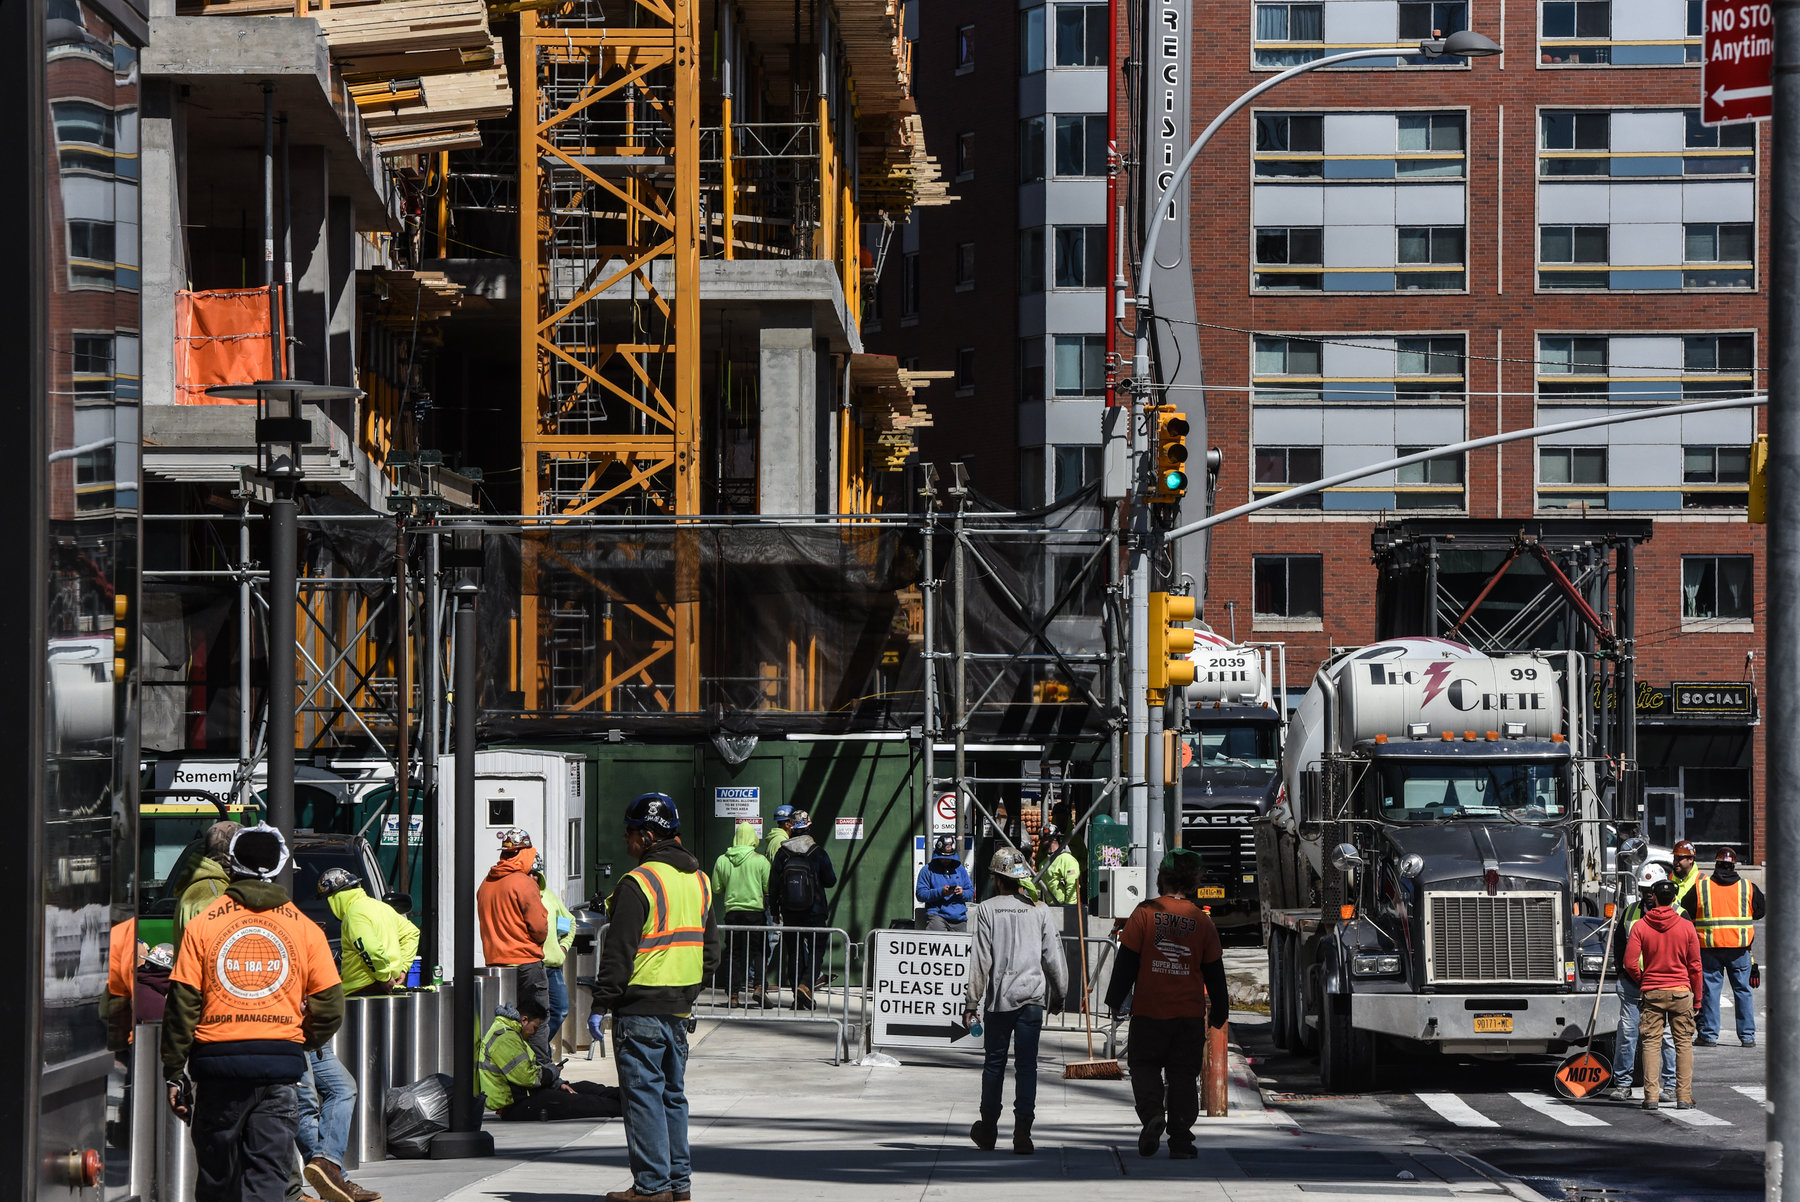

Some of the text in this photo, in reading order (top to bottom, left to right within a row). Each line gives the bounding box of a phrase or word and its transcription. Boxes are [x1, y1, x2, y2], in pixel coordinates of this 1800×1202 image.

[1711, 3, 1774, 33] NO STO
[1209, 658, 1246, 667] 2039
[1510, 668, 1538, 681] 99
[1360, 662, 1546, 711] TEC CRETE
[1681, 692, 1743, 705] SOCIAL
[720, 789, 754, 798] NOTICE
[212, 923, 240, 957] CONCRETE
[241, 918, 278, 931] WORKERS
[220, 934, 236, 958] JUSTICE
[266, 932, 287, 959] STRENGTH
[226, 959, 281, 972] 6A 18A 20
[898, 961, 965, 977] CLOSED
[879, 980, 944, 996] PLEASE
[880, 1000, 935, 1015] OTHER
[205, 1014, 293, 1024] LABOR MANAGEMENT
[1565, 1067, 1602, 1083] SLOW
